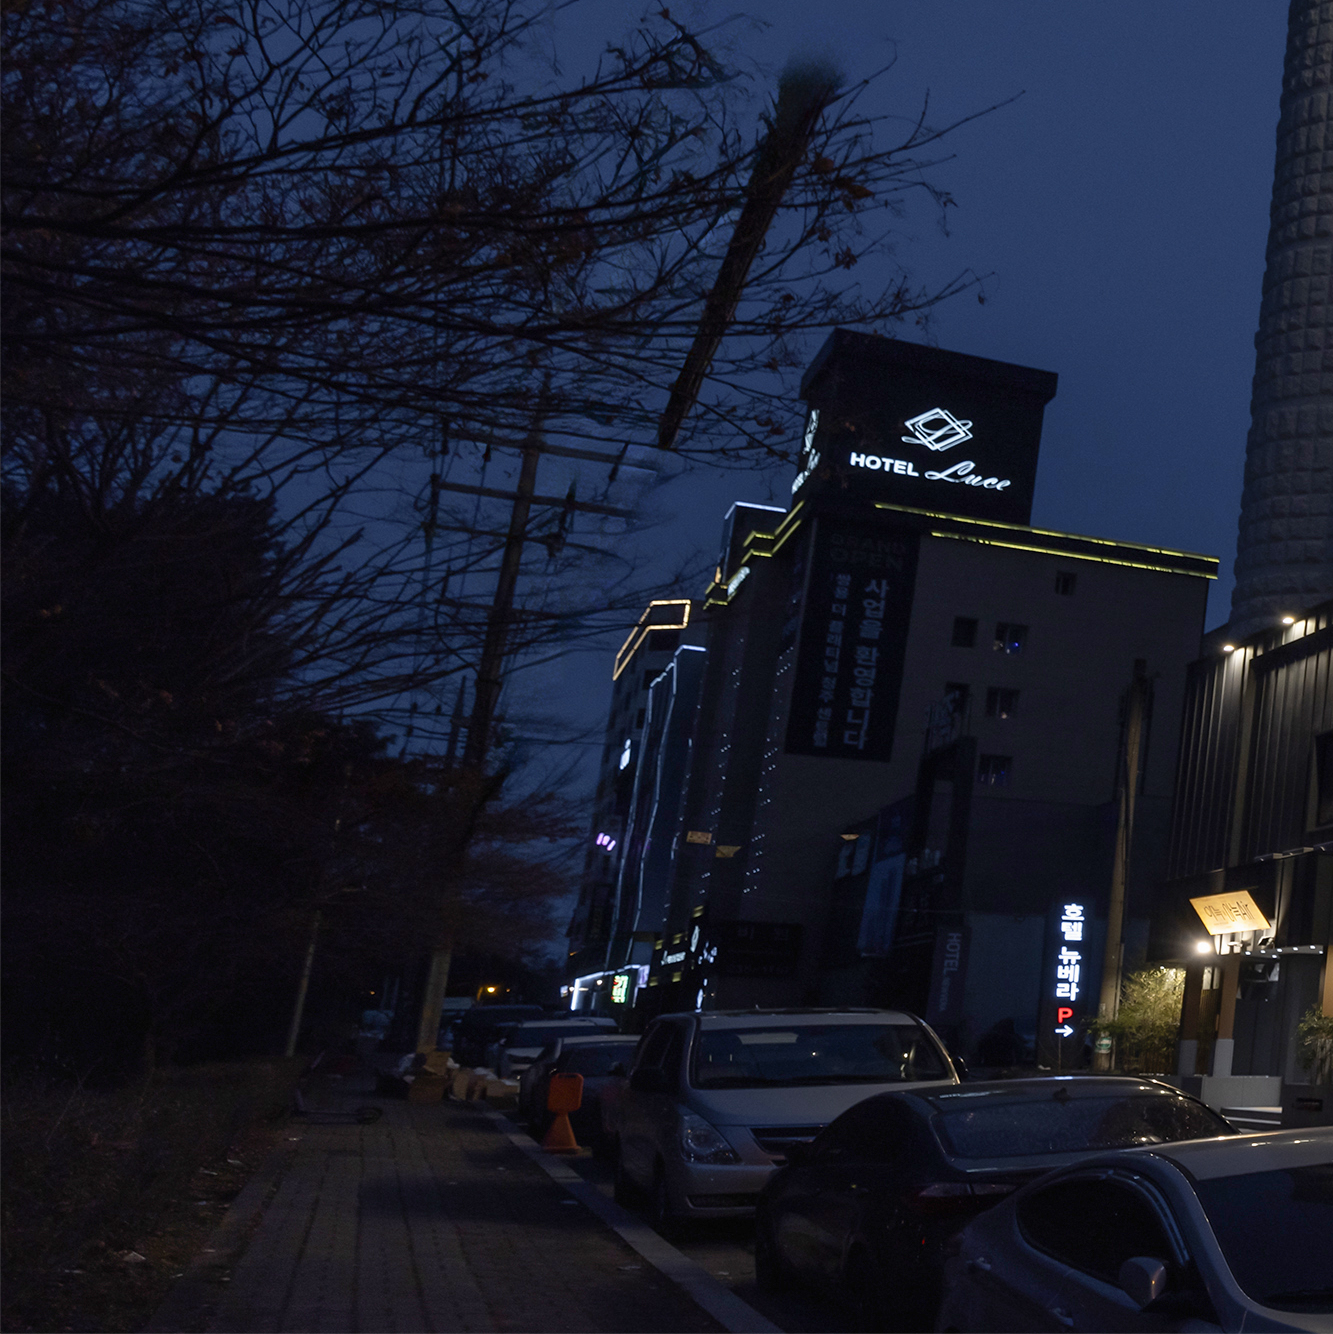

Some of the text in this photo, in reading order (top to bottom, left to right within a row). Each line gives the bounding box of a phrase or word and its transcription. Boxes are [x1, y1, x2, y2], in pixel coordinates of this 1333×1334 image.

[850, 451, 1011, 491] HOTEL Luce
[843, 646, 880, 750] 환영합니다
[943, 932, 962, 975] HOTEL
[1055, 903, 1085, 1002] 호텔 뉴베라
[1057, 1007, 1074, 1024] P
